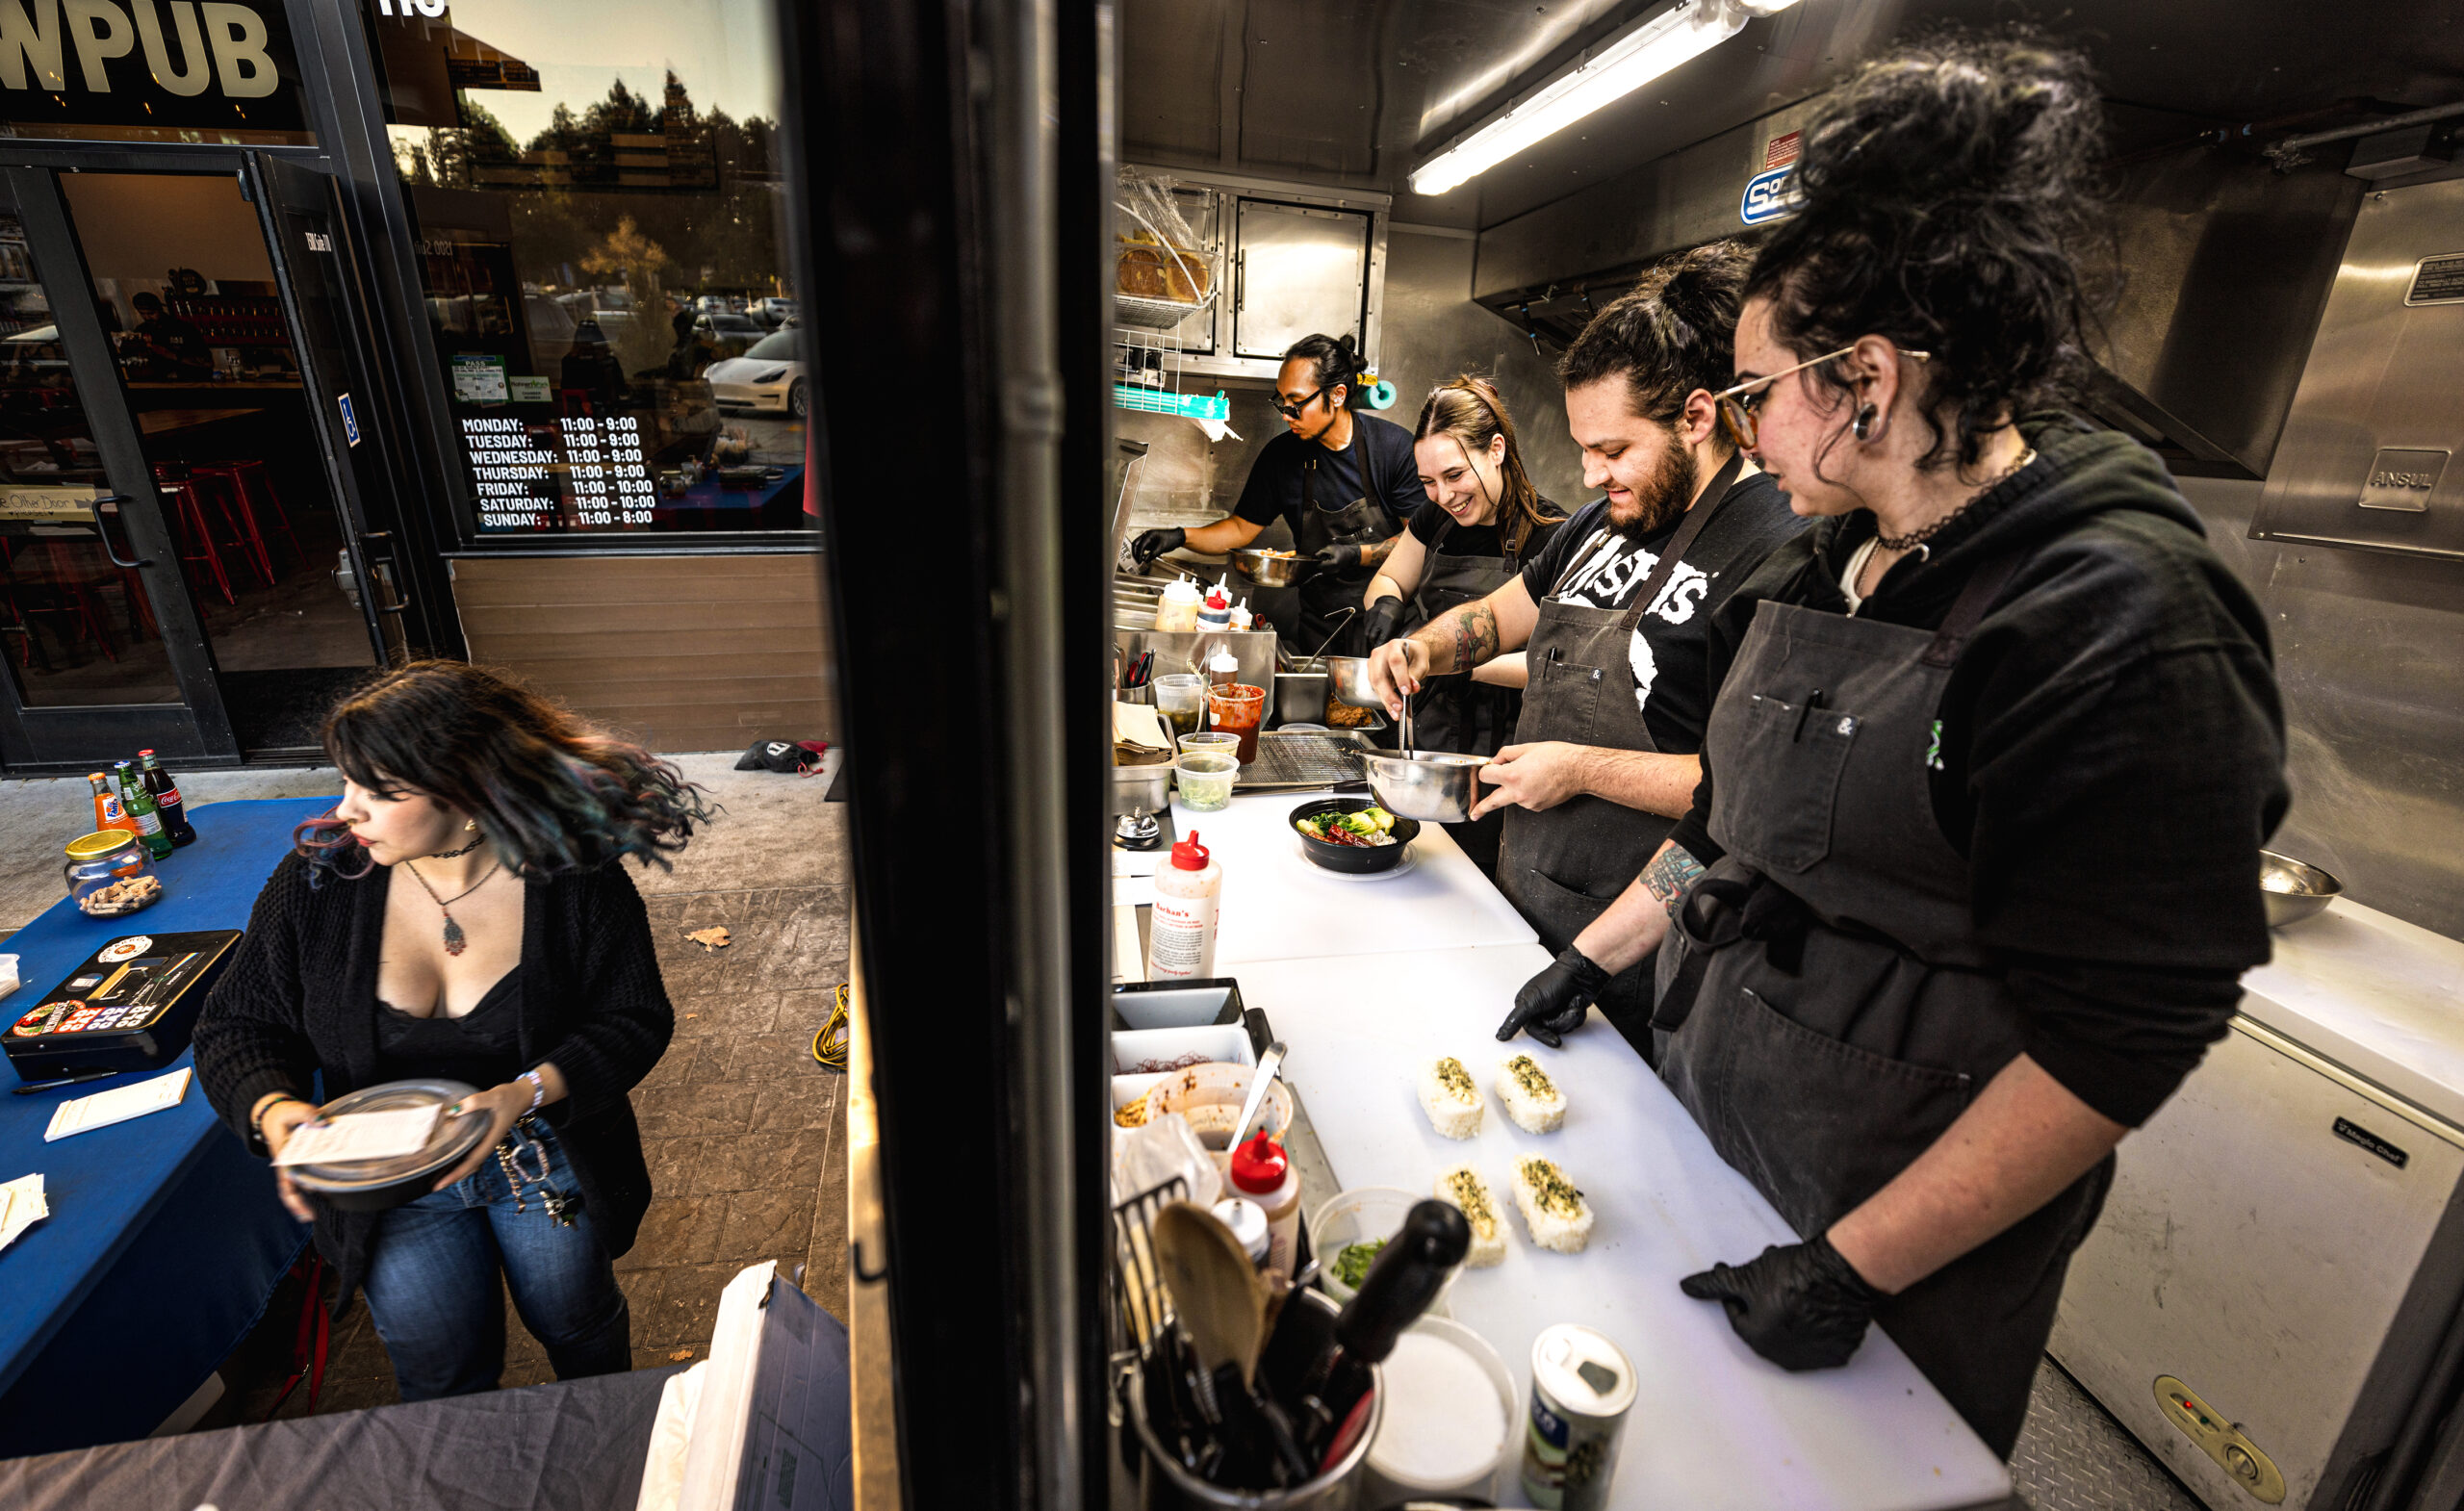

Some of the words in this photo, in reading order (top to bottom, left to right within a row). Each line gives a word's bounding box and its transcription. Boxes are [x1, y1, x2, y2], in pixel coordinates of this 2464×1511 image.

[462, 419, 524, 432] MONDAY:
[560, 418, 595, 431] 11:00
[606, 417, 637, 430] 9:00
[466, 434, 533, 448] TUESDAY:
[563, 433, 598, 447] 11:00
[609, 433, 640, 447] 9:00
[469, 450, 558, 464] WEDNESDAY:
[567, 449, 601, 463] 11:00
[611, 448, 642, 462] 9:00
[473, 466, 550, 479] THURSDAY:
[570, 465, 603, 478] 11:00
[614, 465, 645, 477] 9:00
[2371, 471, 2431, 489] ANSUL
[476, 482, 528, 496] FRIDAY:
[573, 481, 606, 494] 11:00
[617, 480, 653, 493] 10:00
[10, 494, 39, 508] Other
[40, 495, 70, 509] Door
[480, 498, 554, 511] SATURDAY:
[576, 496, 608, 509] 11:00
[619, 495, 655, 508] 10:00
[483, 513, 541, 526] SUNDAY:
[578, 511, 611, 525] 11:00
[623, 510, 653, 524] 8:00
[1552, 528, 1708, 626] MISFTS
[1155, 902, 1190, 918] Bachan's
[59, 1009, 90, 1032] OLD
[87, 1007, 118, 1030] OLD
[116, 1005, 145, 1028] OLD
[2376, 1144, 2400, 1162] Chef
